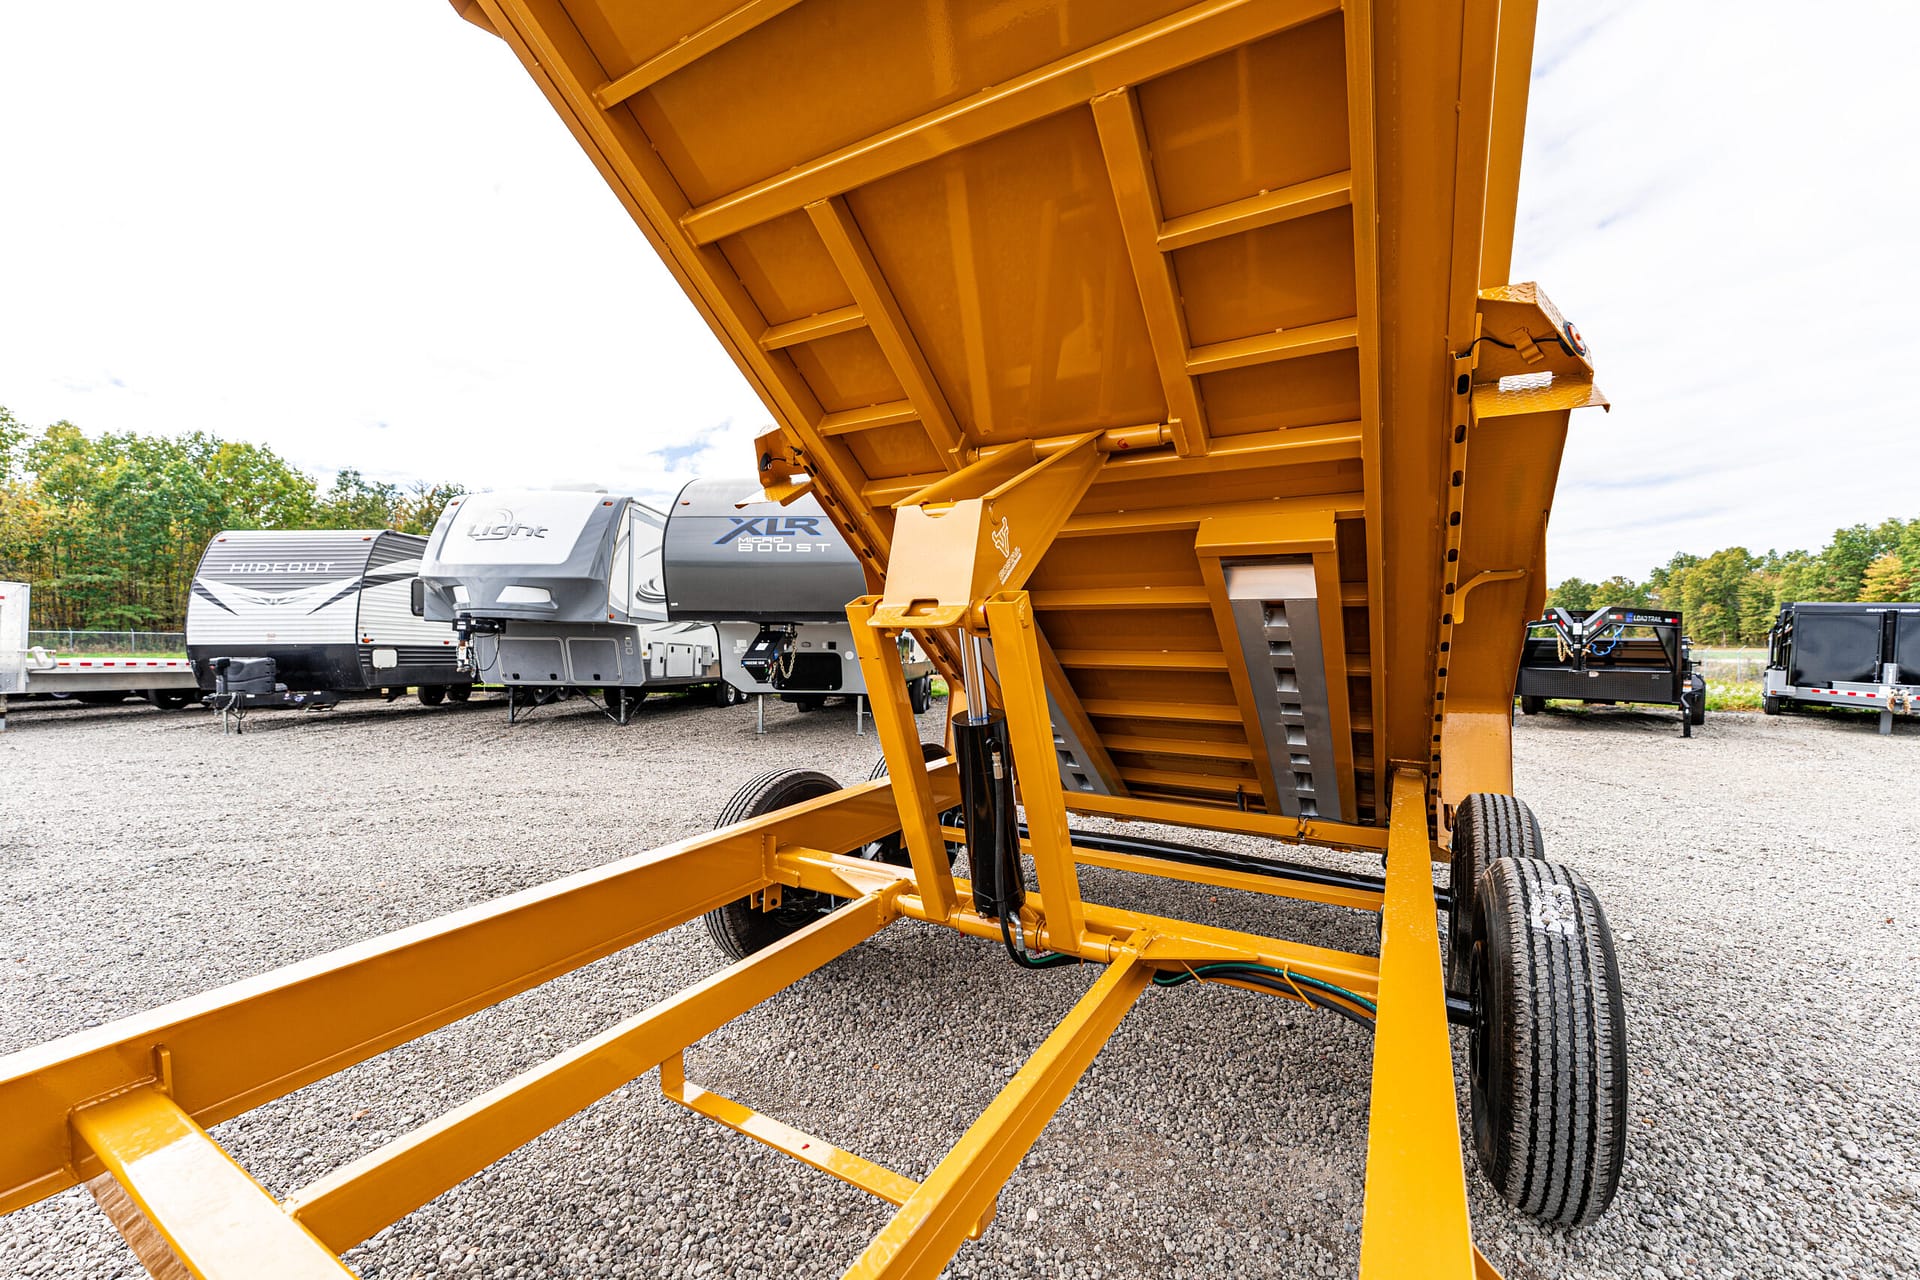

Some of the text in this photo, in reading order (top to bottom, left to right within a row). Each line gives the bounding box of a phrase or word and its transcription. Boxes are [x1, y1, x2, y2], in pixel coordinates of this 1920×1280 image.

[712, 517, 823, 545] XLR
[738, 543, 832, 553] BOOST
[229, 562, 335, 574] HIDEOUT
